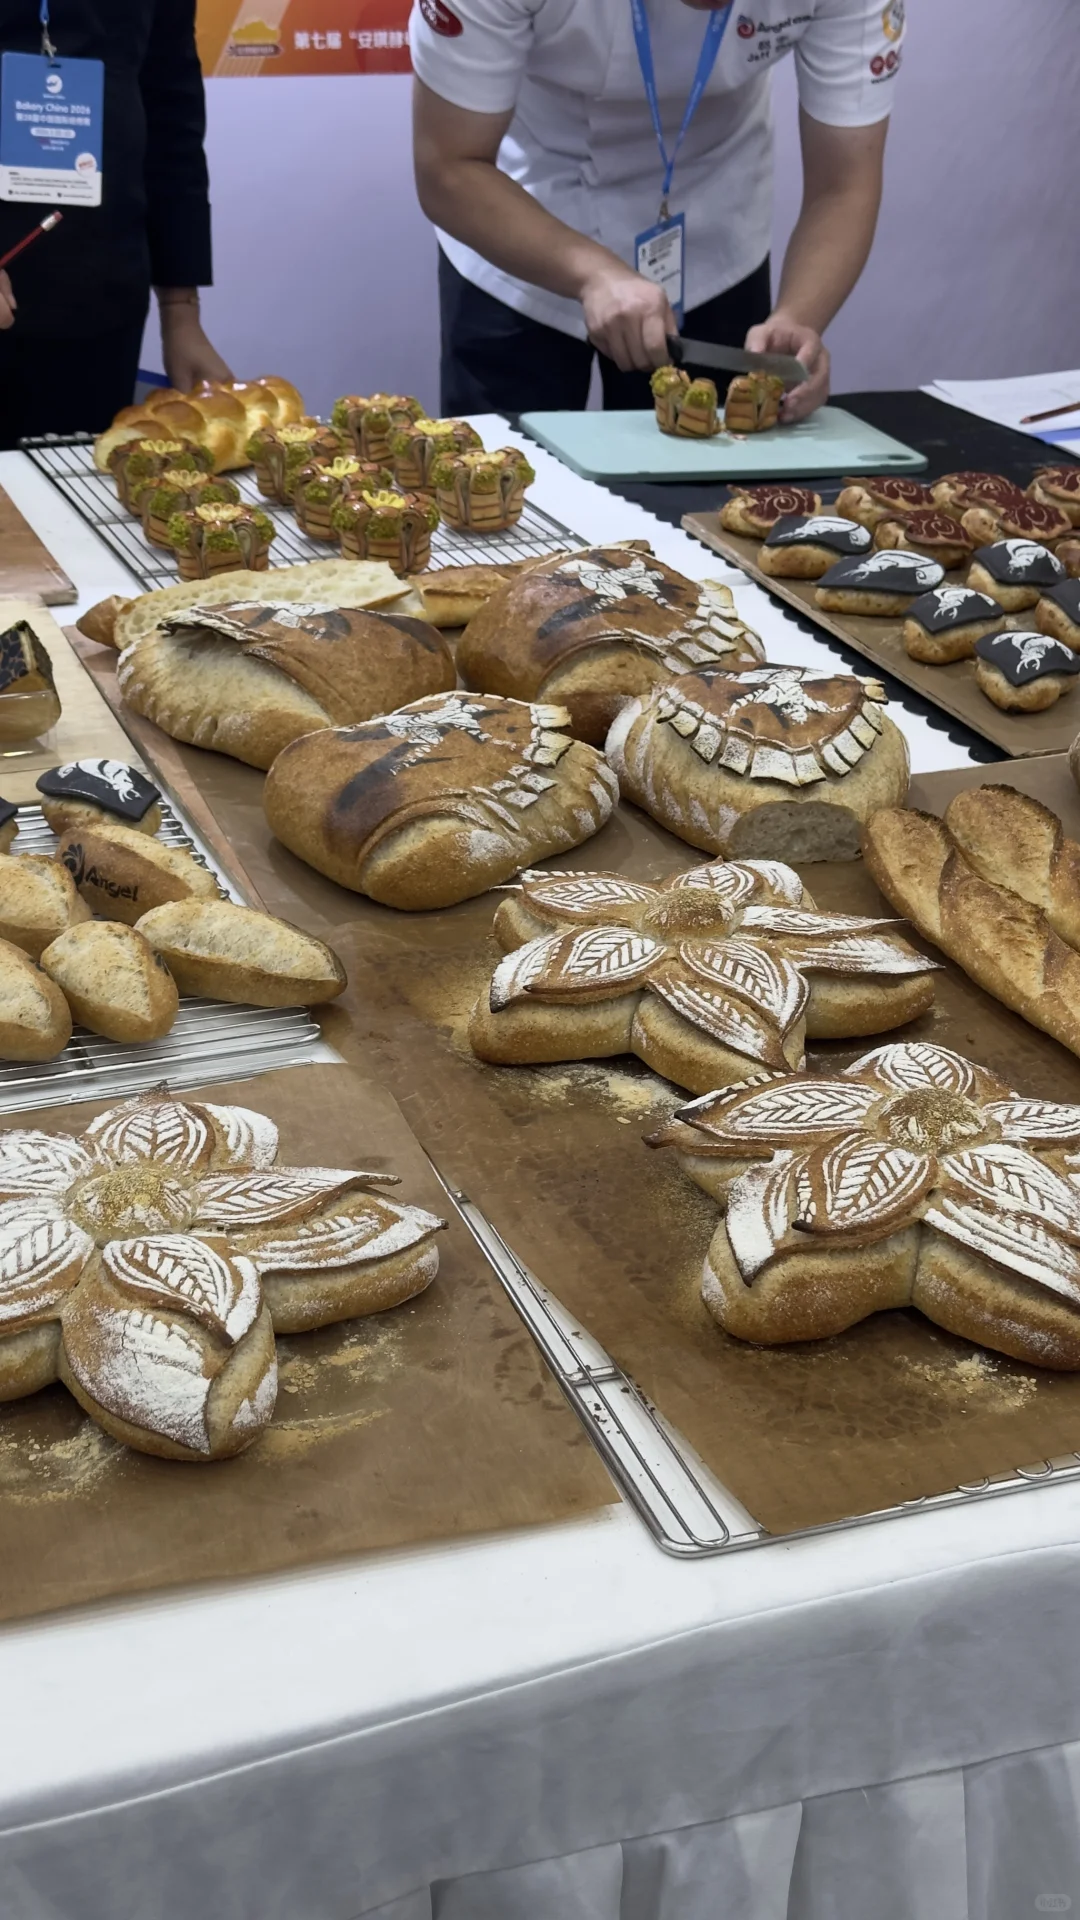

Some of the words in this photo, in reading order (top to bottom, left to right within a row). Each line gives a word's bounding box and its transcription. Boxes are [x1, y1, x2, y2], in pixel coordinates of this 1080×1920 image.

[757, 17, 791, 33] Angel
[15, 101, 43, 112] Bakery
[45, 103, 68, 113] China
[86, 866, 139, 901] Angel
